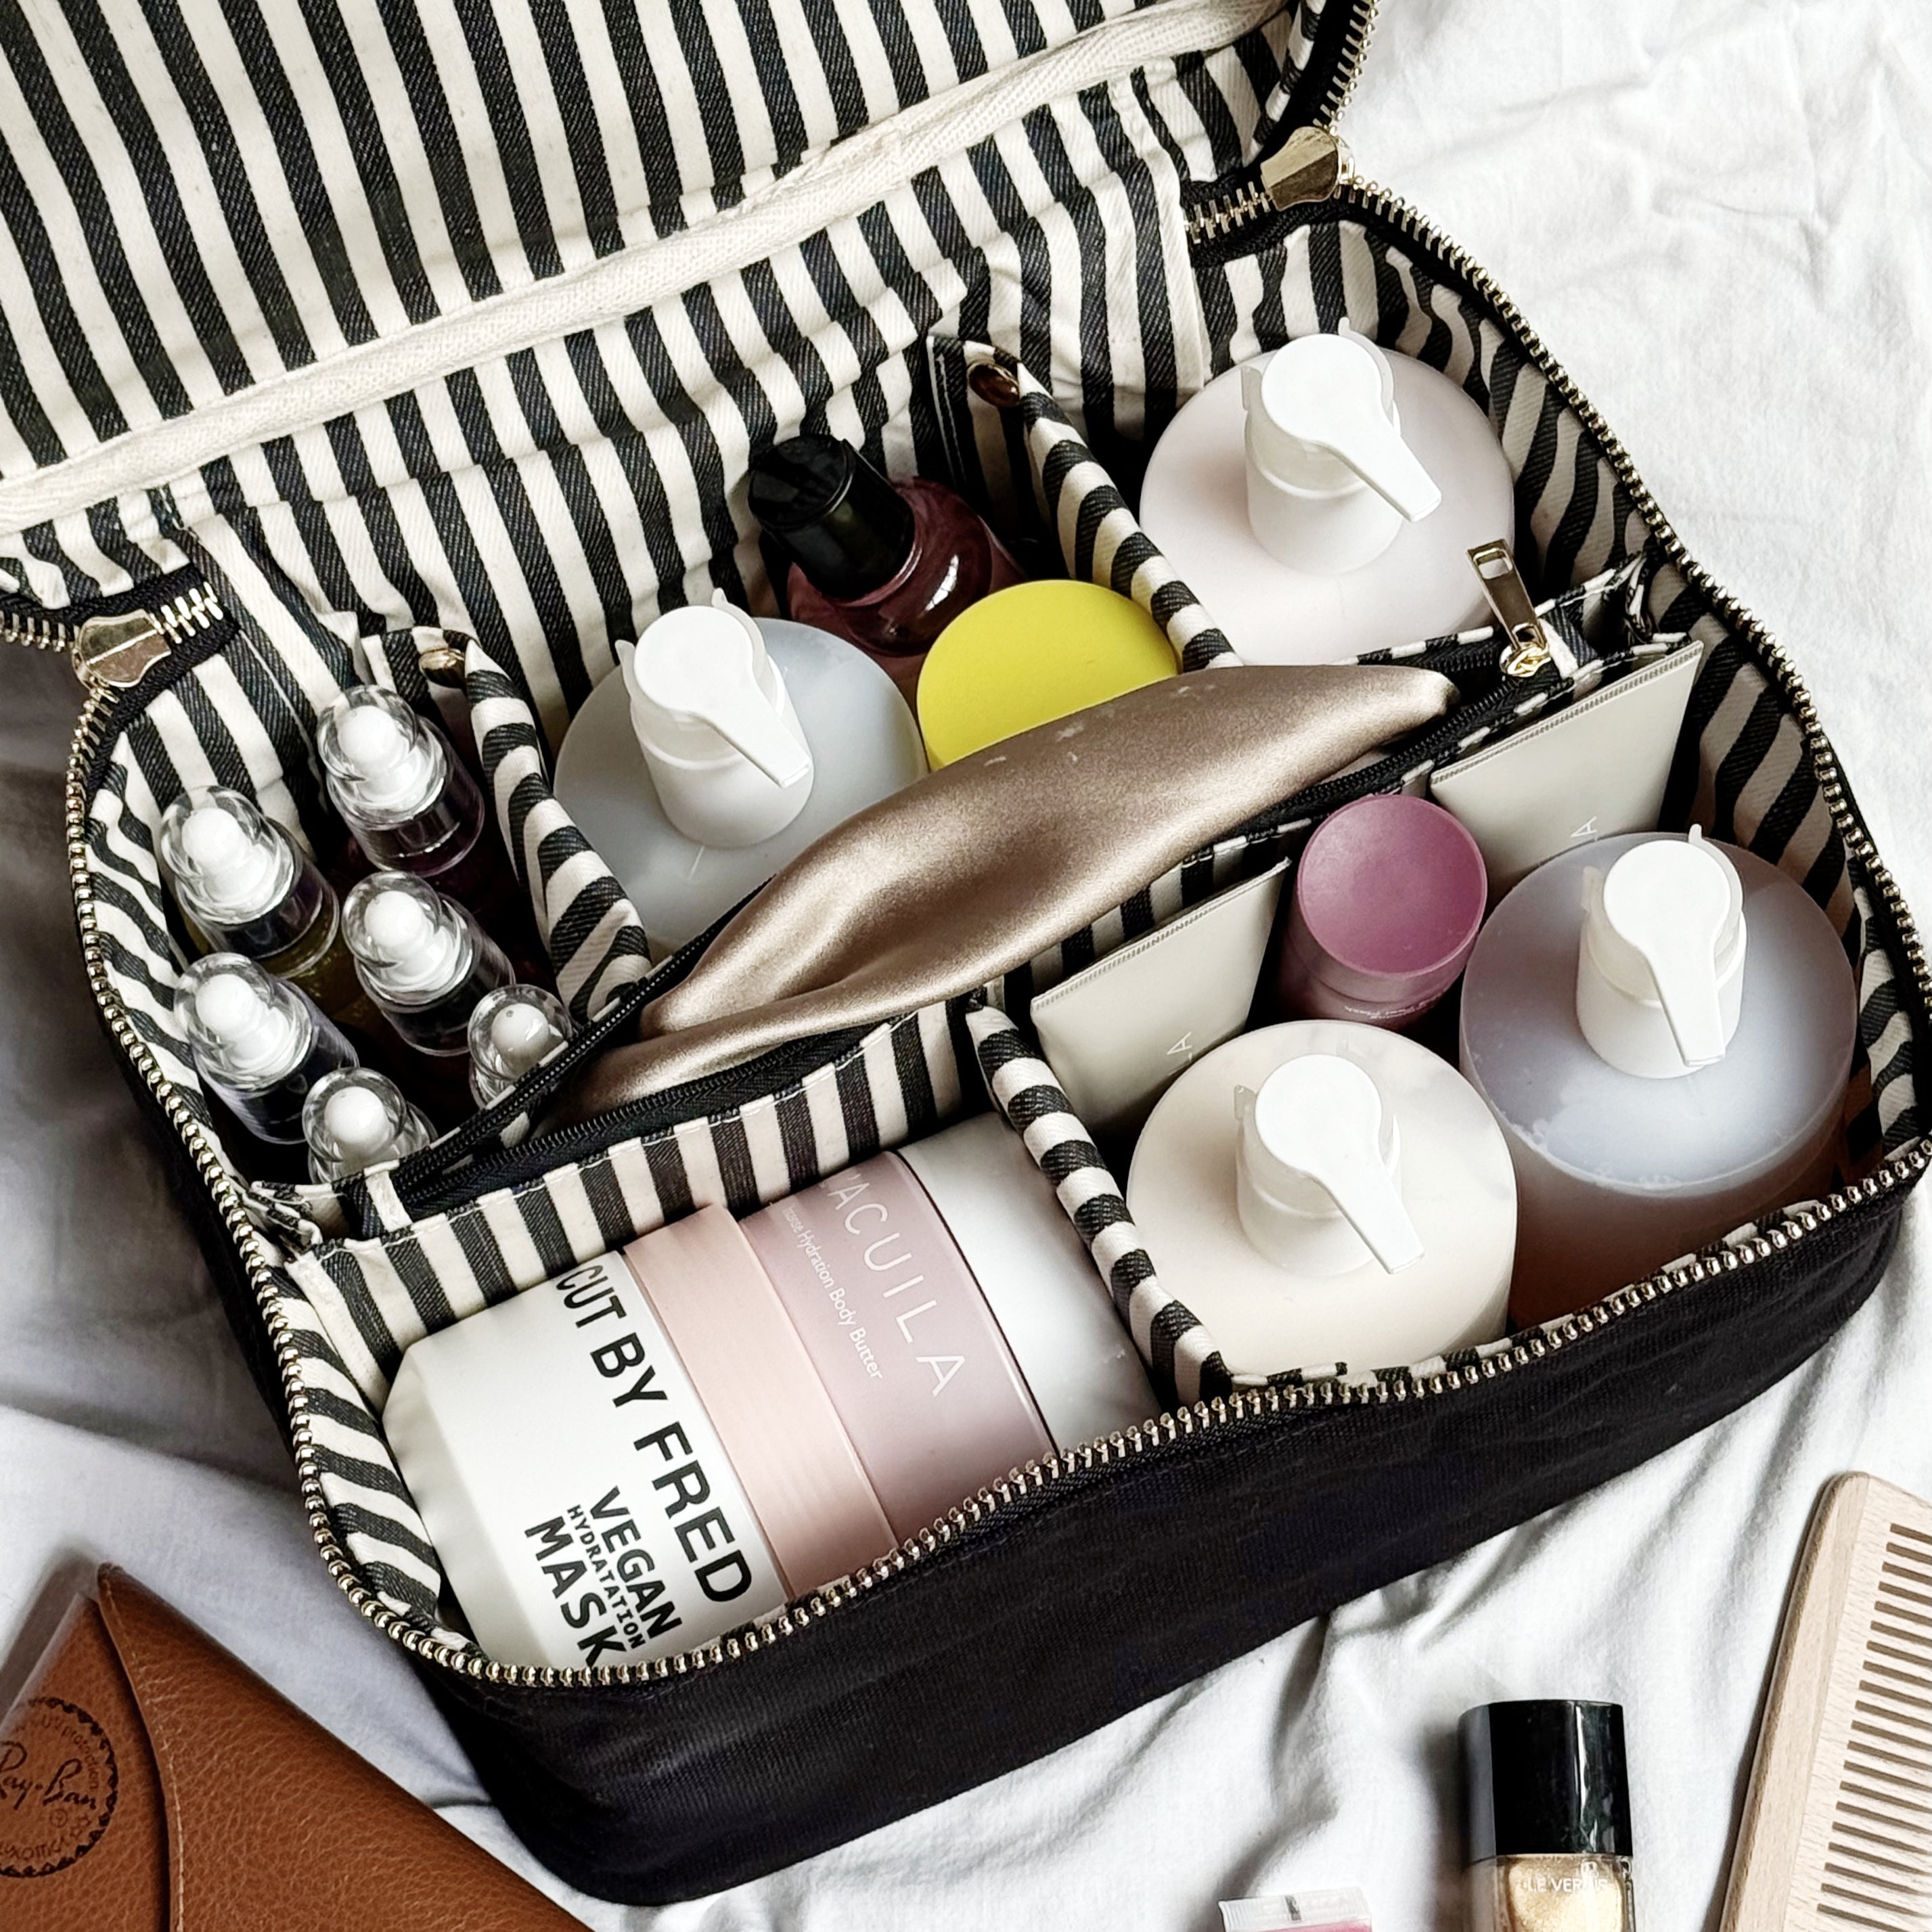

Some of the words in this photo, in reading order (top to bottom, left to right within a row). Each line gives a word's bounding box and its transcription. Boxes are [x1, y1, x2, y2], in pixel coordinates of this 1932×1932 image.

[556, 1264, 627, 1329] CUT
[589, 1332, 669, 1408] BY
[796, 1230, 834, 1288] Hydration
[829, 1287, 857, 1326] Body
[849, 1326, 883, 1379] Butter
[567, 1504, 646, 1649] HYDRATATION
[589, 1485, 683, 1640] VEGAN
[633, 1420, 752, 1602] FRED
[524, 1515, 627, 1667] MASK
[1550, 1877, 1609, 1893] VERIS
